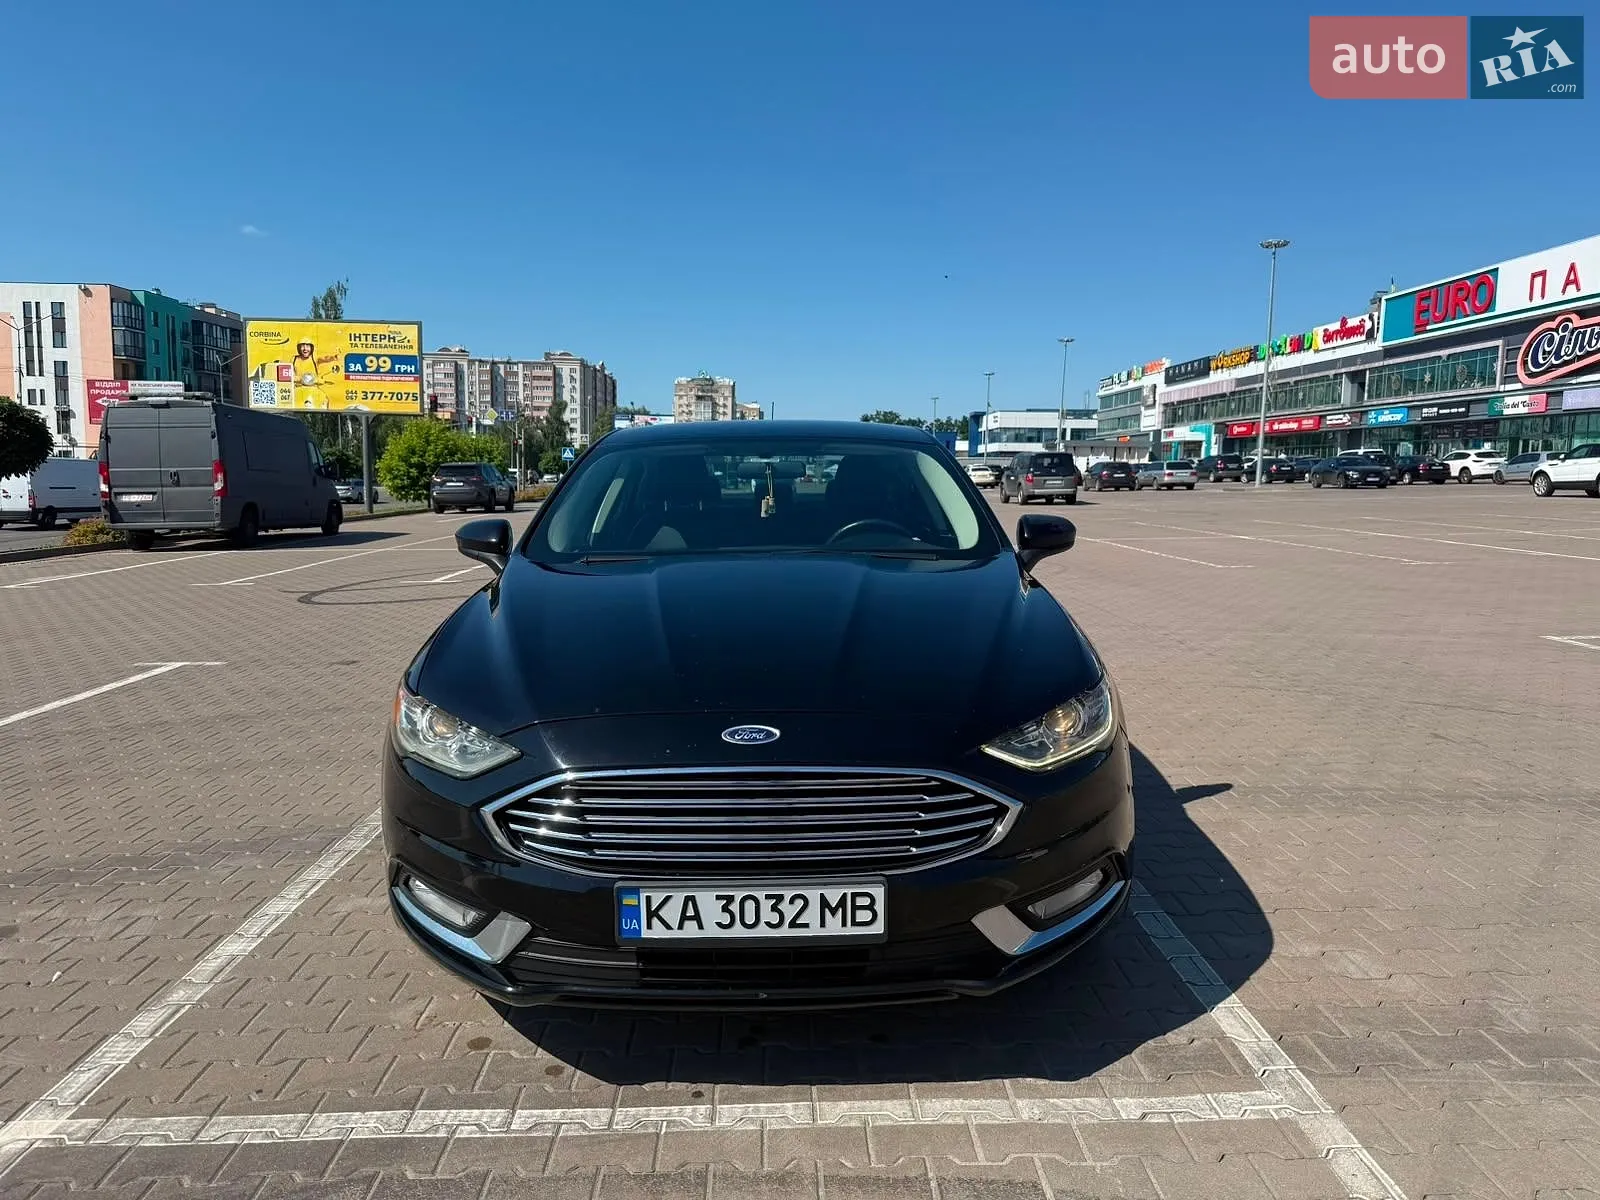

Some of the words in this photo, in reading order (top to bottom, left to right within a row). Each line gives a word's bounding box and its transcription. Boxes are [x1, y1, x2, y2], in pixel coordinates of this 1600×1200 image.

[1413, 273, 1496, 328] EURO
[348, 363, 363, 372] ЗА
[365, 356, 392, 372] 99
[395, 364, 415, 373] ГРН
[361, 391, 419, 402] 377-7075
[734, 728, 767, 739] Ford
[714, 893, 810, 930] 3032
[622, 918, 640, 930] UA
